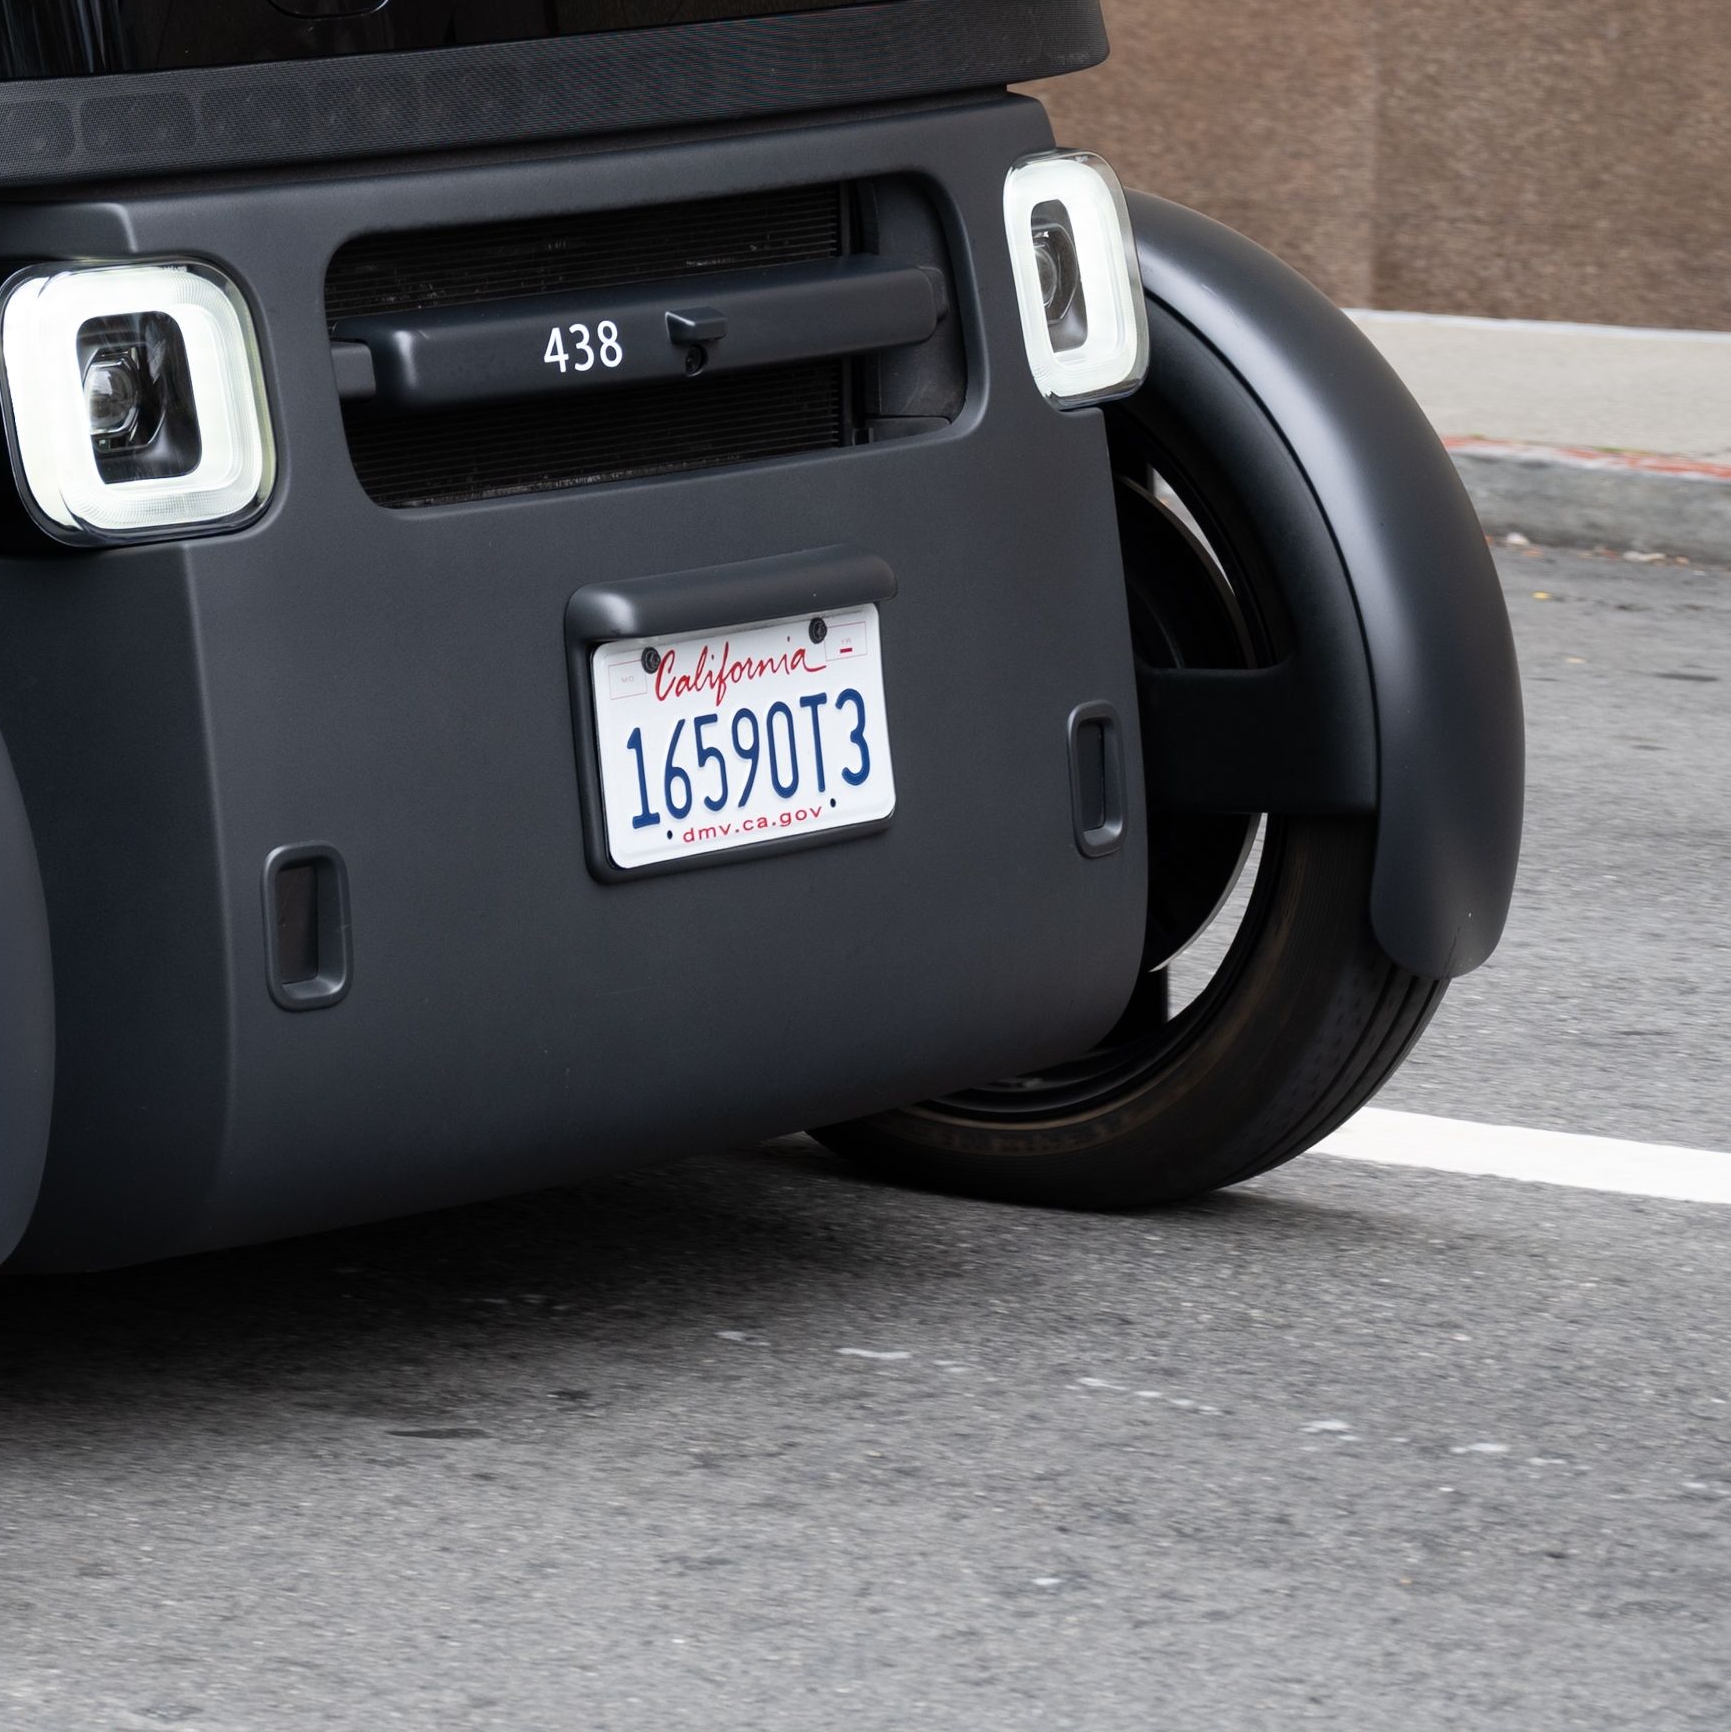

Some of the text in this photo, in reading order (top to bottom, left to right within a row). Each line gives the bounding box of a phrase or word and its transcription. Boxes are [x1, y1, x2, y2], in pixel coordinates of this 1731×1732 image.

[543, 320, 623, 373] 438
[655, 636, 827, 706] California
[626, 688, 871, 830] 16590T3
[682, 805, 823, 844] dmv.ca.gov
